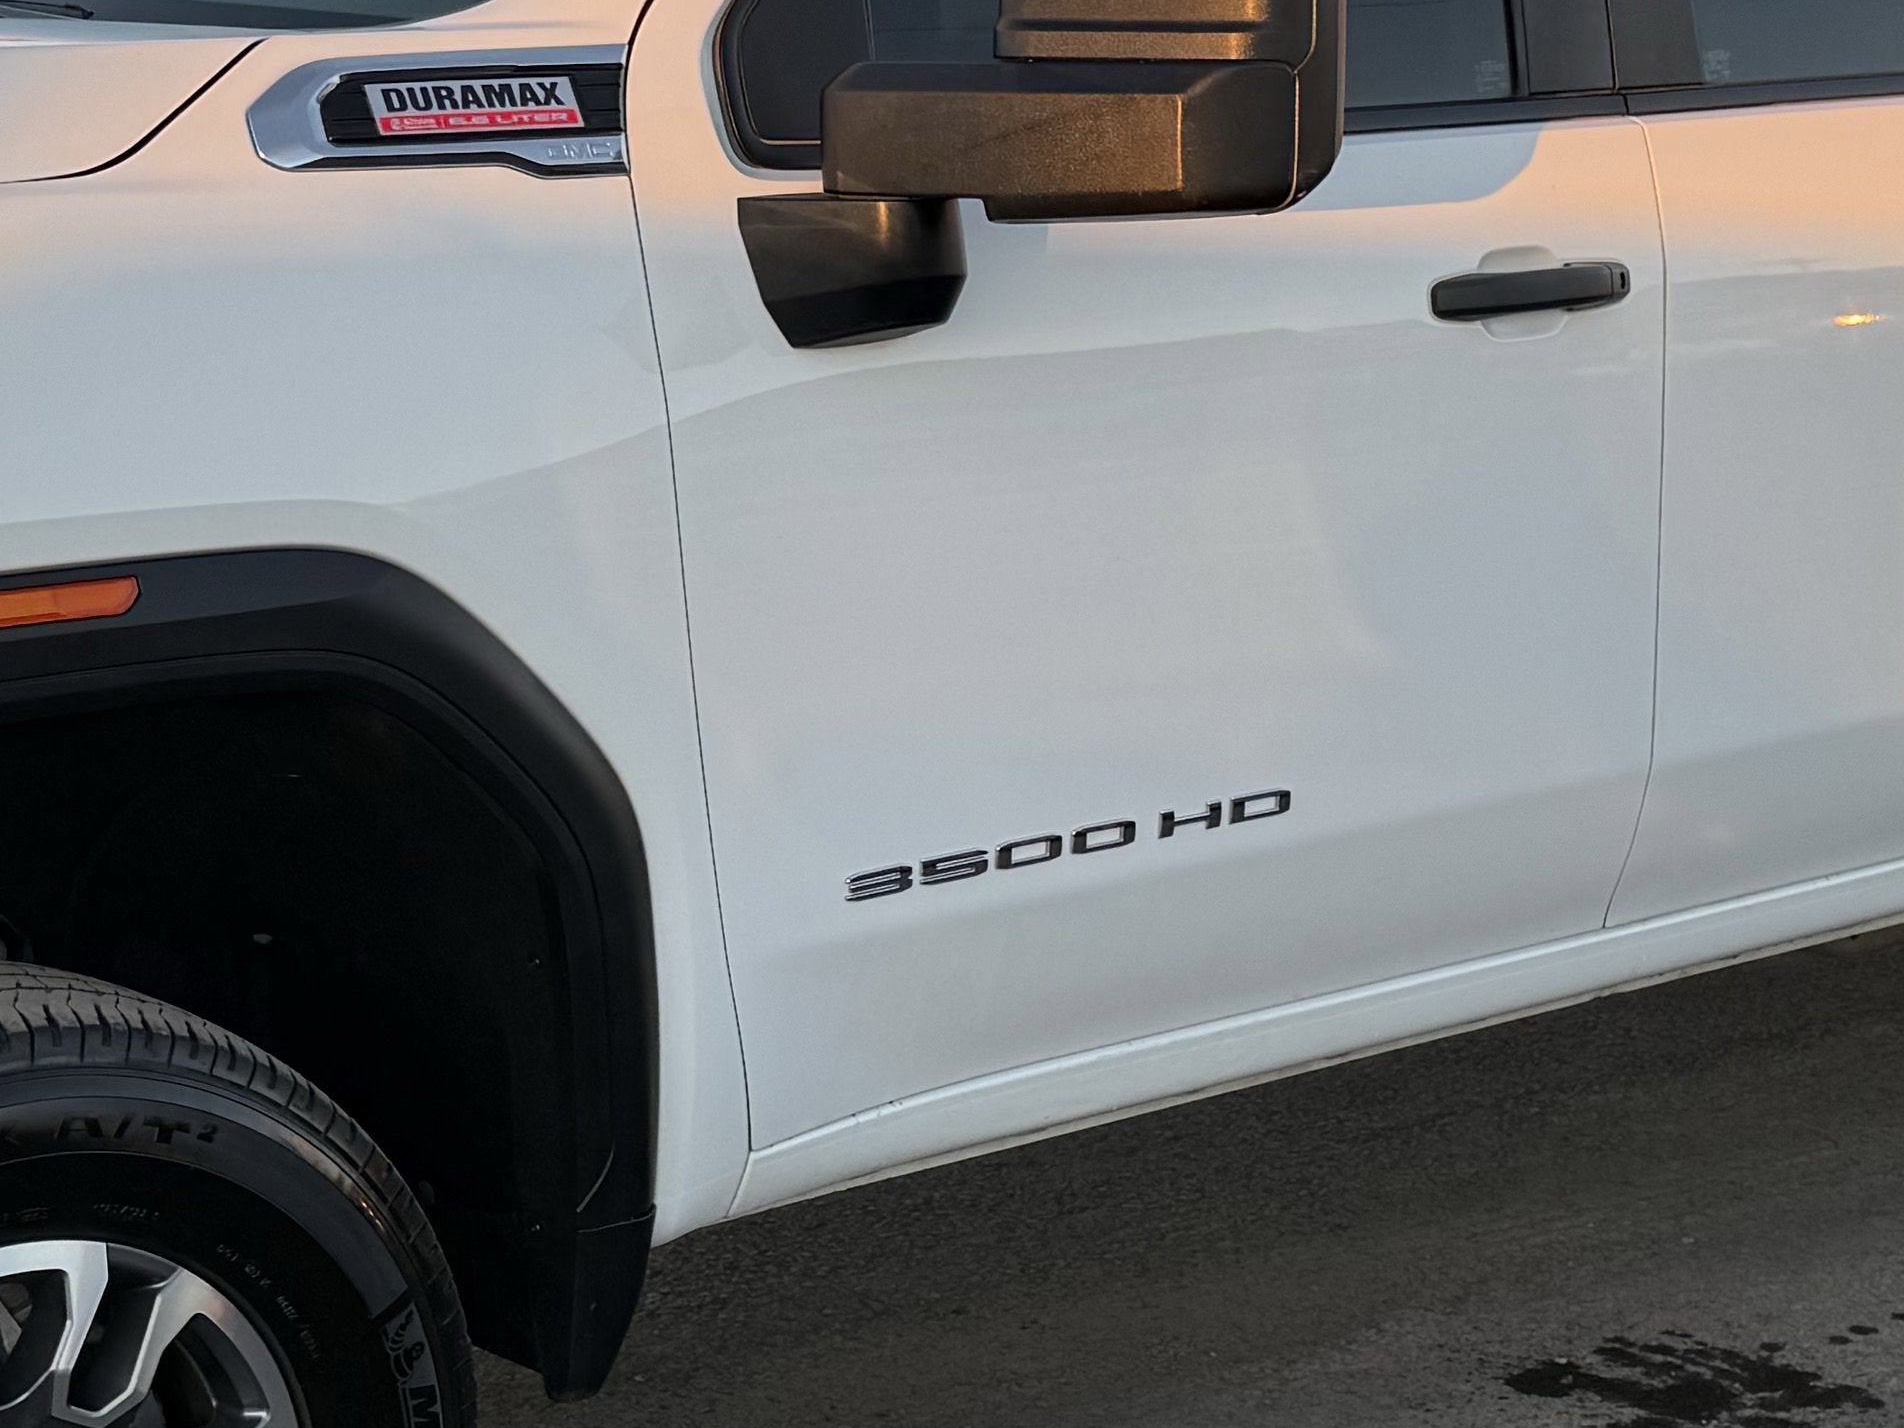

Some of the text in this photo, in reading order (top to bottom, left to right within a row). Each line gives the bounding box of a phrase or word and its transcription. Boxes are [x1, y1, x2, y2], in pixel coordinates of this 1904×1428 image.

[380, 81, 566, 113] DURAMAX
[497, 110, 570, 125] LITER
[843, 789, 1292, 902] 3500 HD
